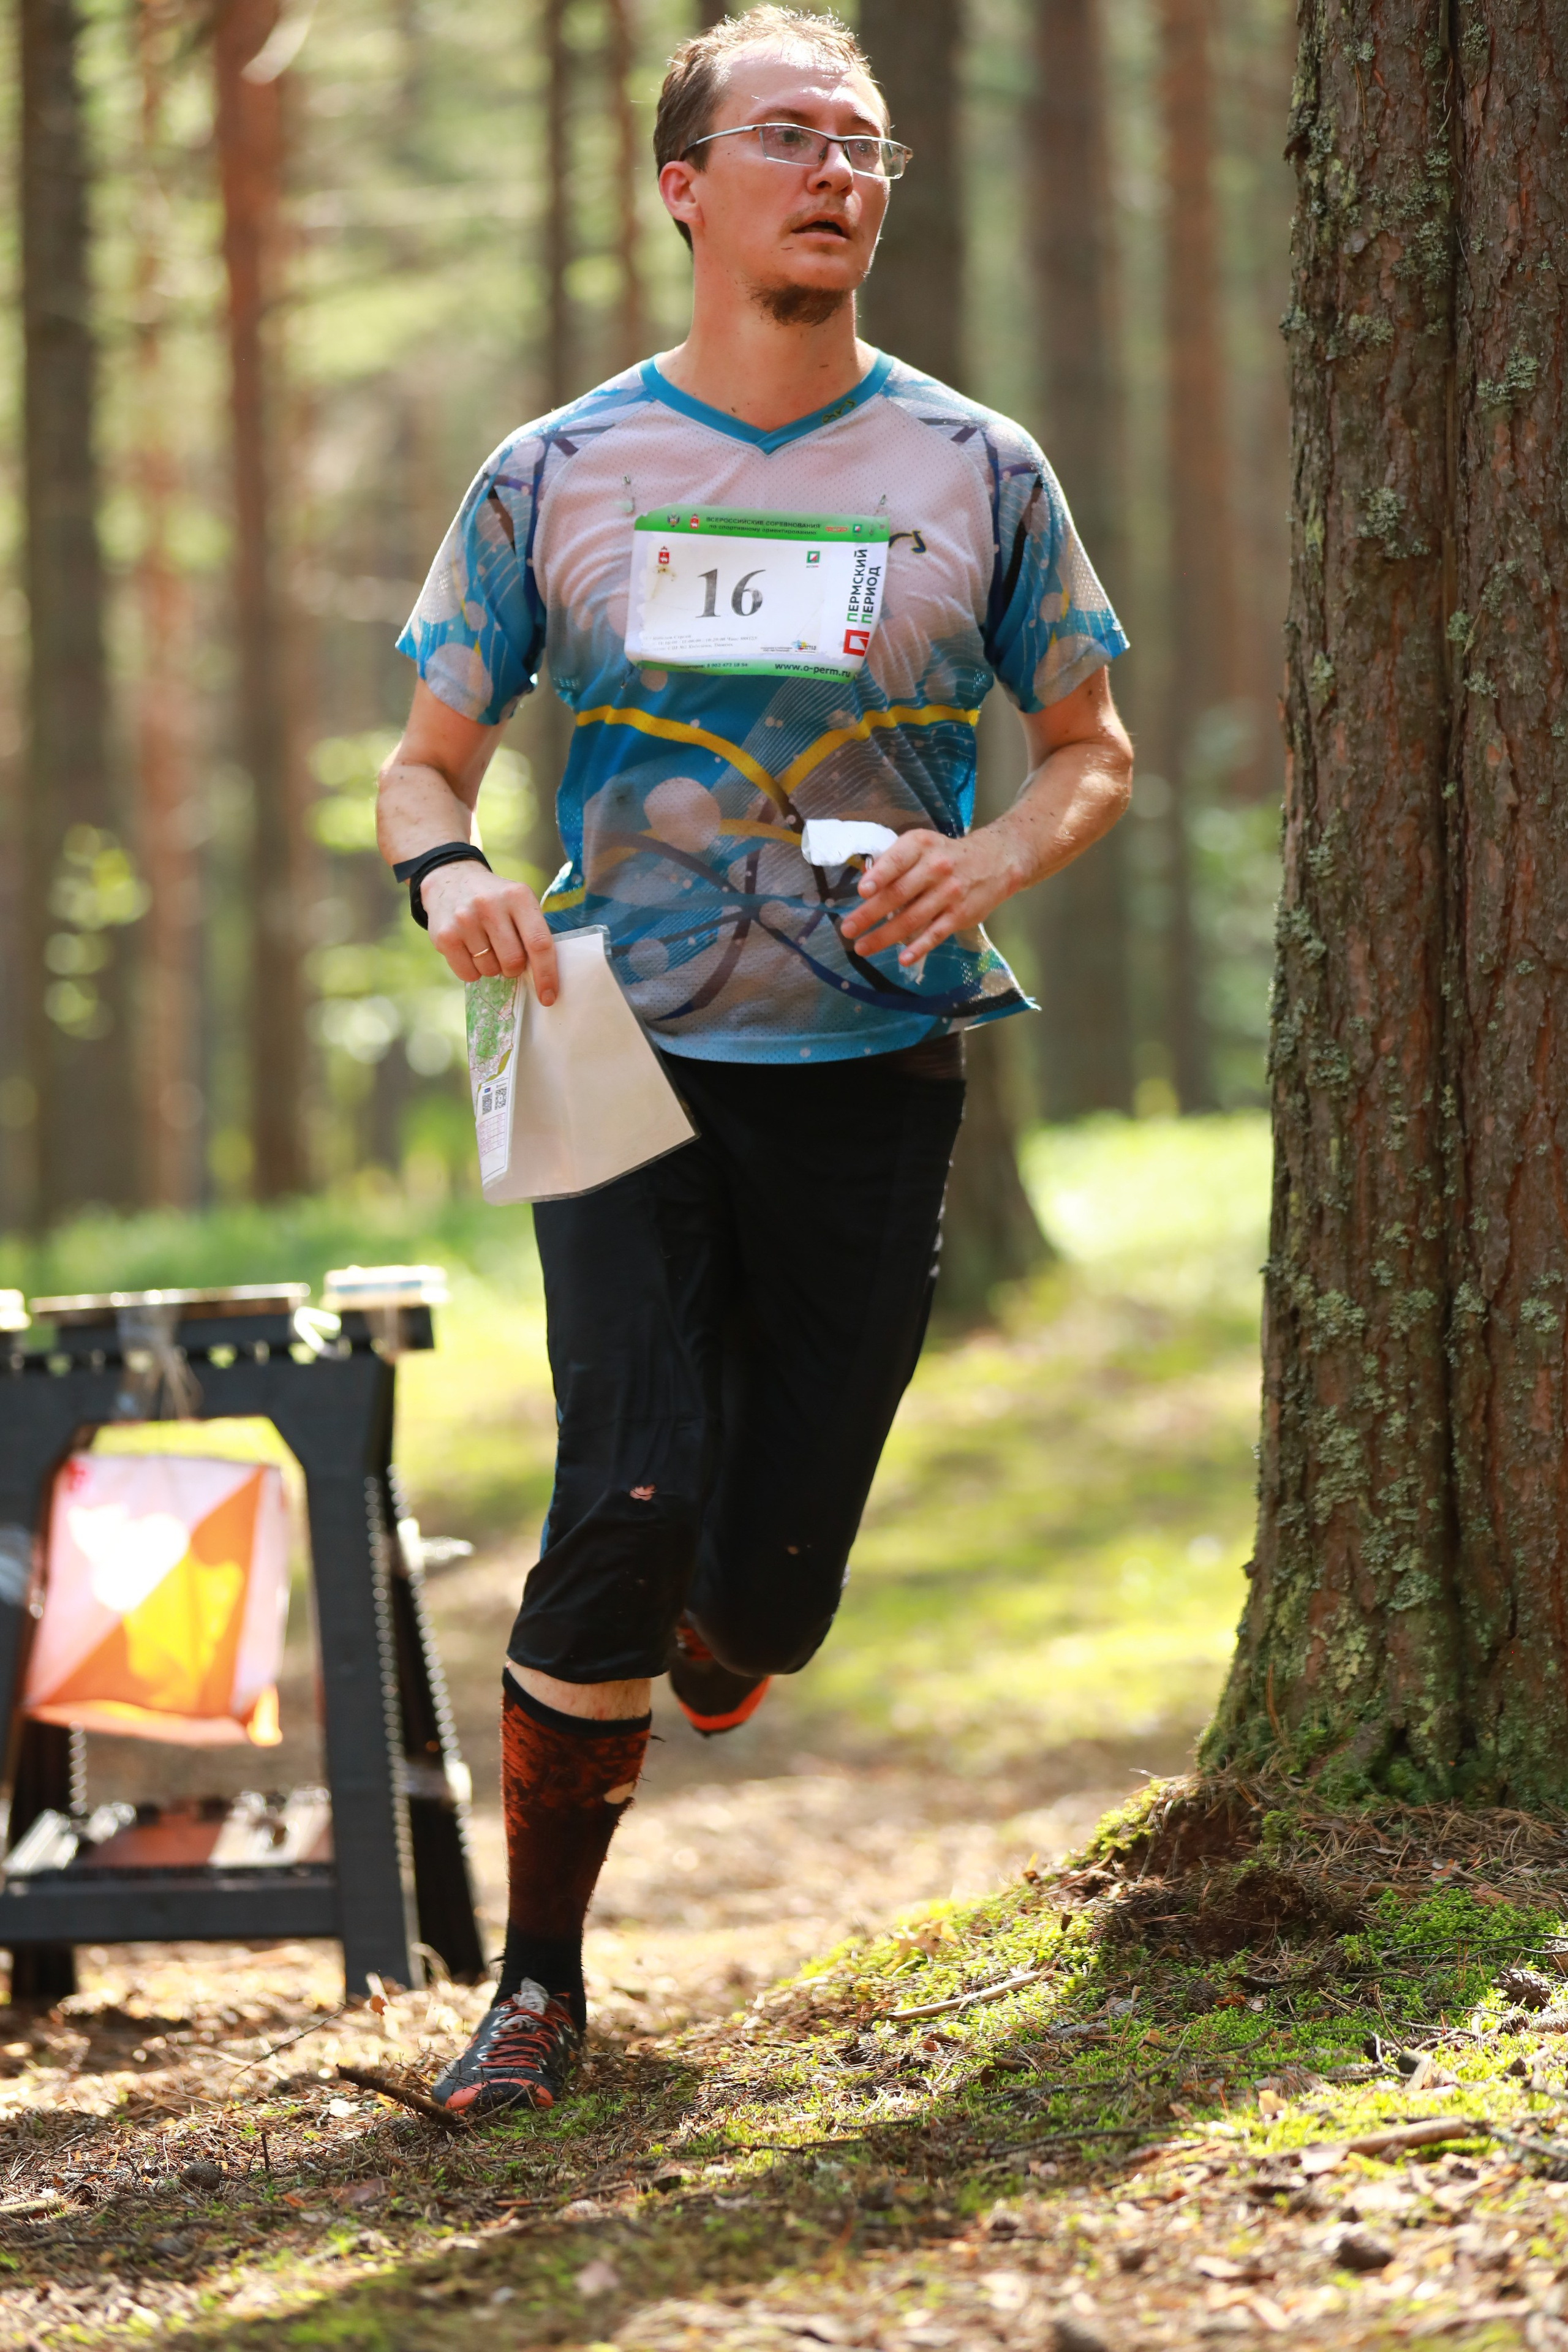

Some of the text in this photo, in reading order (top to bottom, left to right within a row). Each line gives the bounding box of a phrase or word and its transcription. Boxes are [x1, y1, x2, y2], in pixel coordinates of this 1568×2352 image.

[706, 516, 763, 526] ВСЕРОССИЙСКИЕ
[695, 568, 766, 618] 16
[846, 549, 868, 623] ПЕРМСКИЙ
[861, 566, 881, 624] ПЕРИОД
[774, 663, 851, 678] www.o-perm.ru
